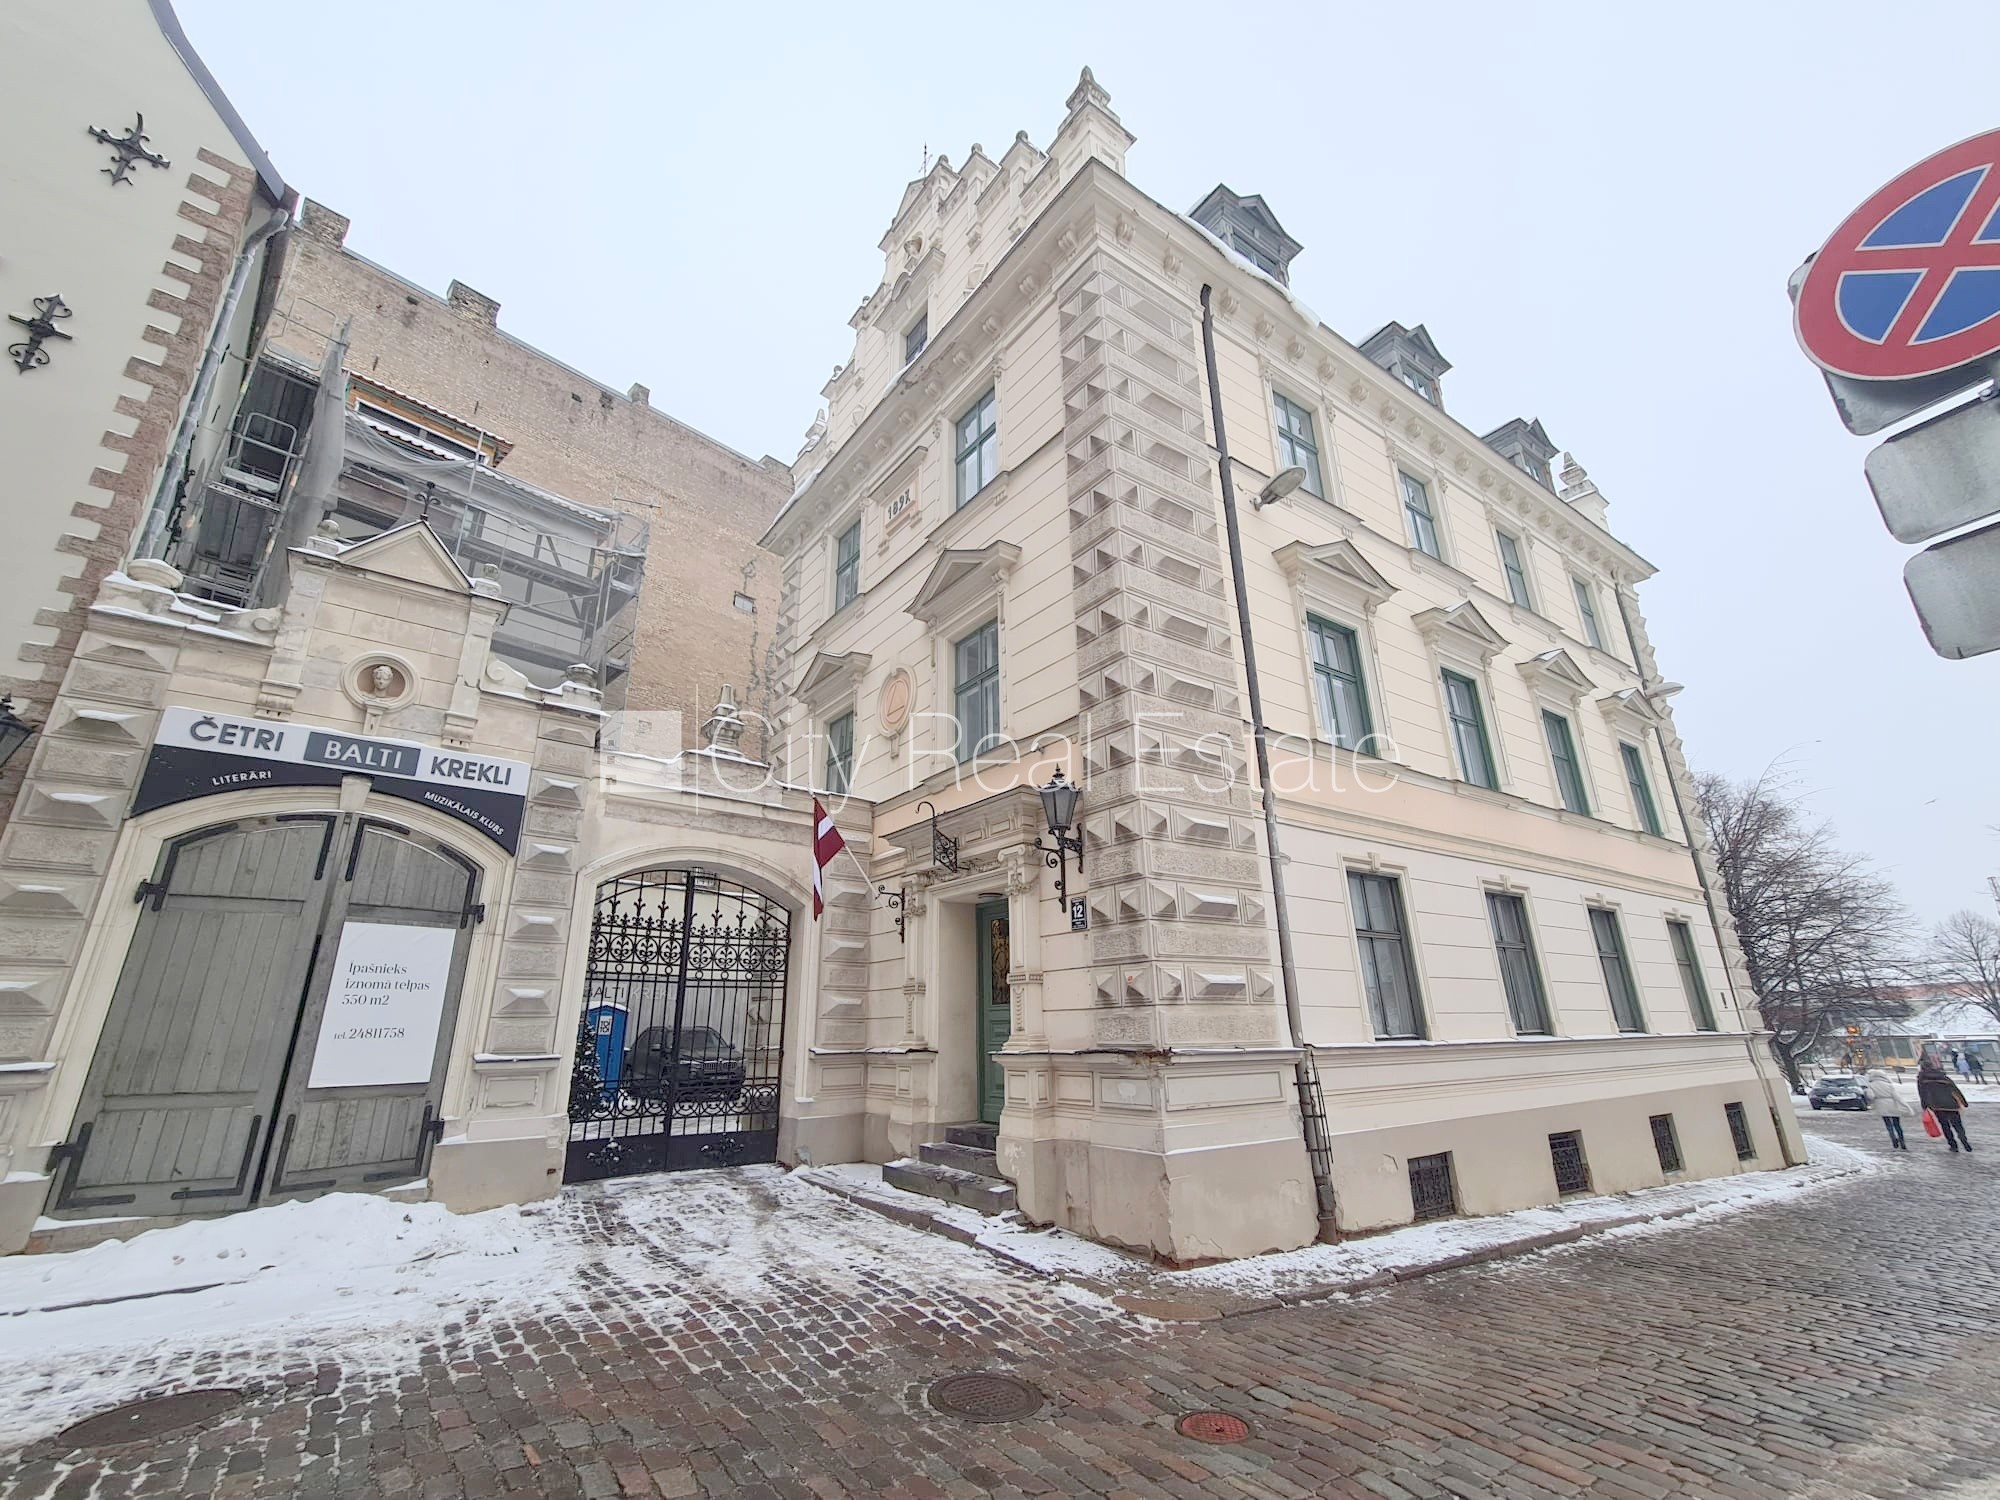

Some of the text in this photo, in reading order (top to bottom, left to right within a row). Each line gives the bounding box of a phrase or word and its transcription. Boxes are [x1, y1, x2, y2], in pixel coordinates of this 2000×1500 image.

[190, 715, 512, 786] ČETRI BALTI KREKLI
[212, 770, 272, 786] LITERĀRI
[424, 791, 505, 836] MUZIKĀLAIS KLUBS
[1072, 903, 1084, 919] 12
[345, 978, 431, 993] iznomā telpas
[341, 994, 390, 1006] 550 m2
[348, 1026, 405, 1040] 24811758
